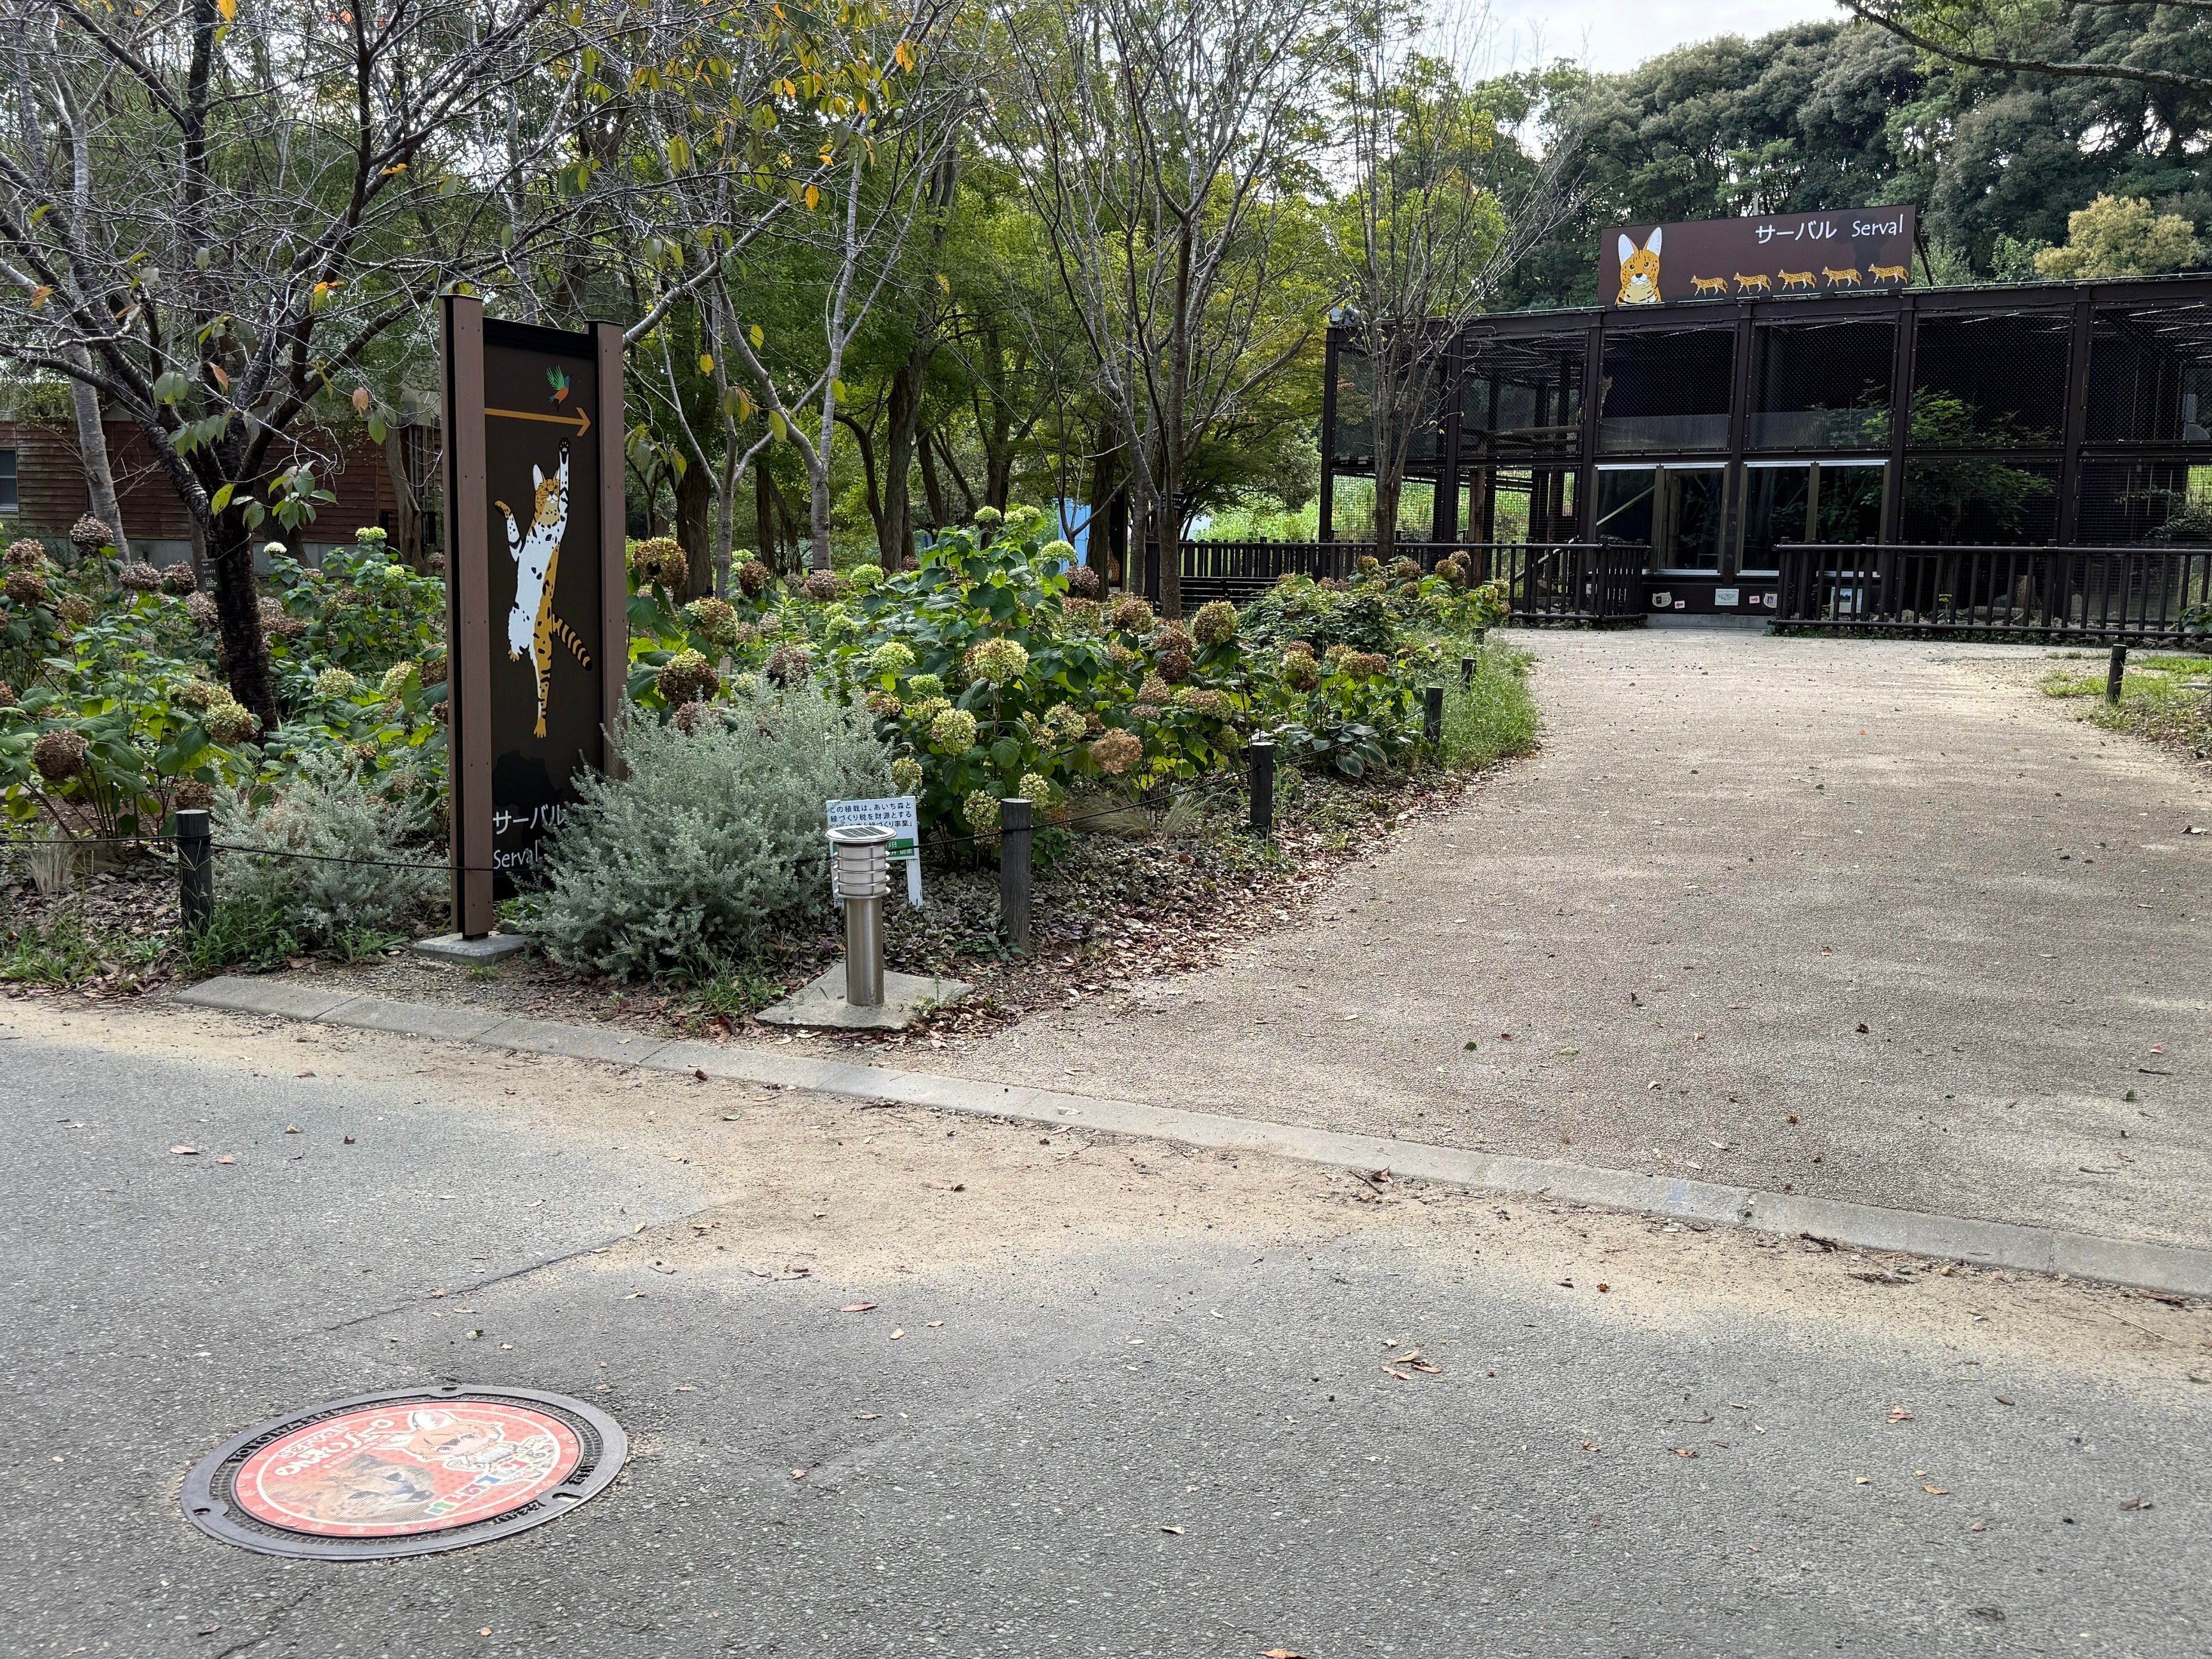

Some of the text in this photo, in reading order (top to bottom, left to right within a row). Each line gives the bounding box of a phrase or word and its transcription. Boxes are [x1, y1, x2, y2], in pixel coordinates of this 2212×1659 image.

[1755, 213, 1904, 244] サーバル Serval
[493, 804, 565, 835] サーバル
[493, 839, 538, 869] Serval
[229, 1409, 340, 1462] TOYOHASHI
[277, 1425, 349, 1458] Serval
